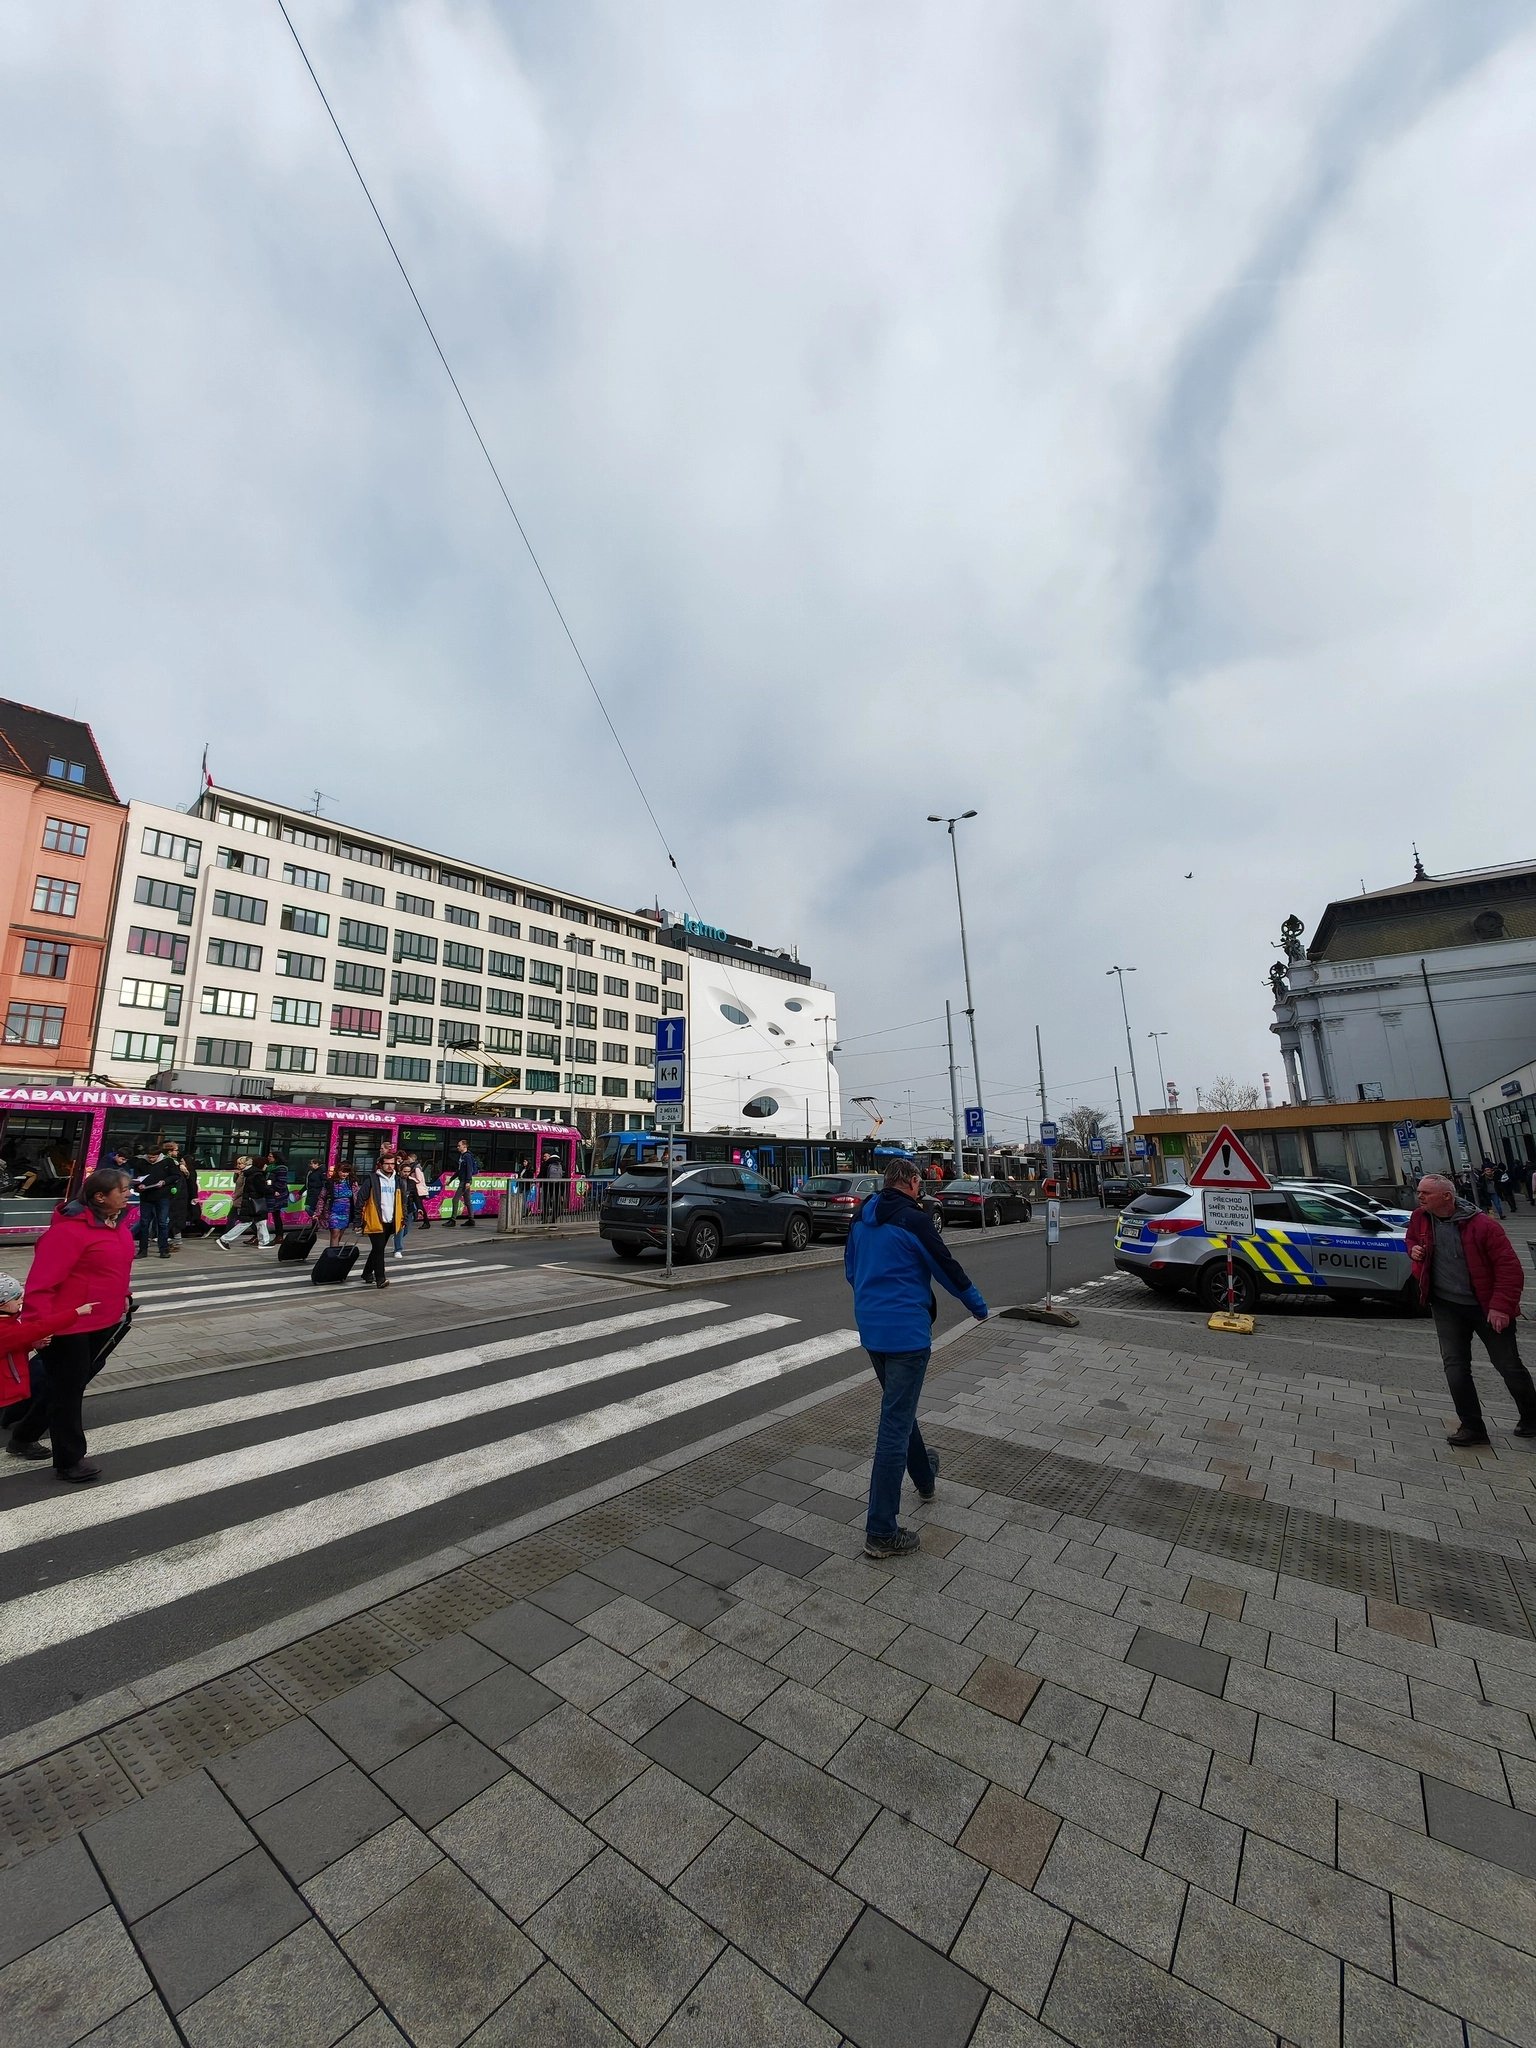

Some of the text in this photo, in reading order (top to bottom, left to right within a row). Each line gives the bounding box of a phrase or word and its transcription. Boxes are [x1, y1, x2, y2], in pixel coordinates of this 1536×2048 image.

[683, 912, 727, 942] letmo
[215, 1101, 263, 1114] PARK
[325, 1111, 396, 1122] www.vida.cz
[969, 1111, 980, 1127] P
[458, 1118, 570, 1134] VIDA! SCIENCE CENTRUM
[402, 1131, 411, 1140] 12
[1318, 1253, 1388, 1270] POLICIE
